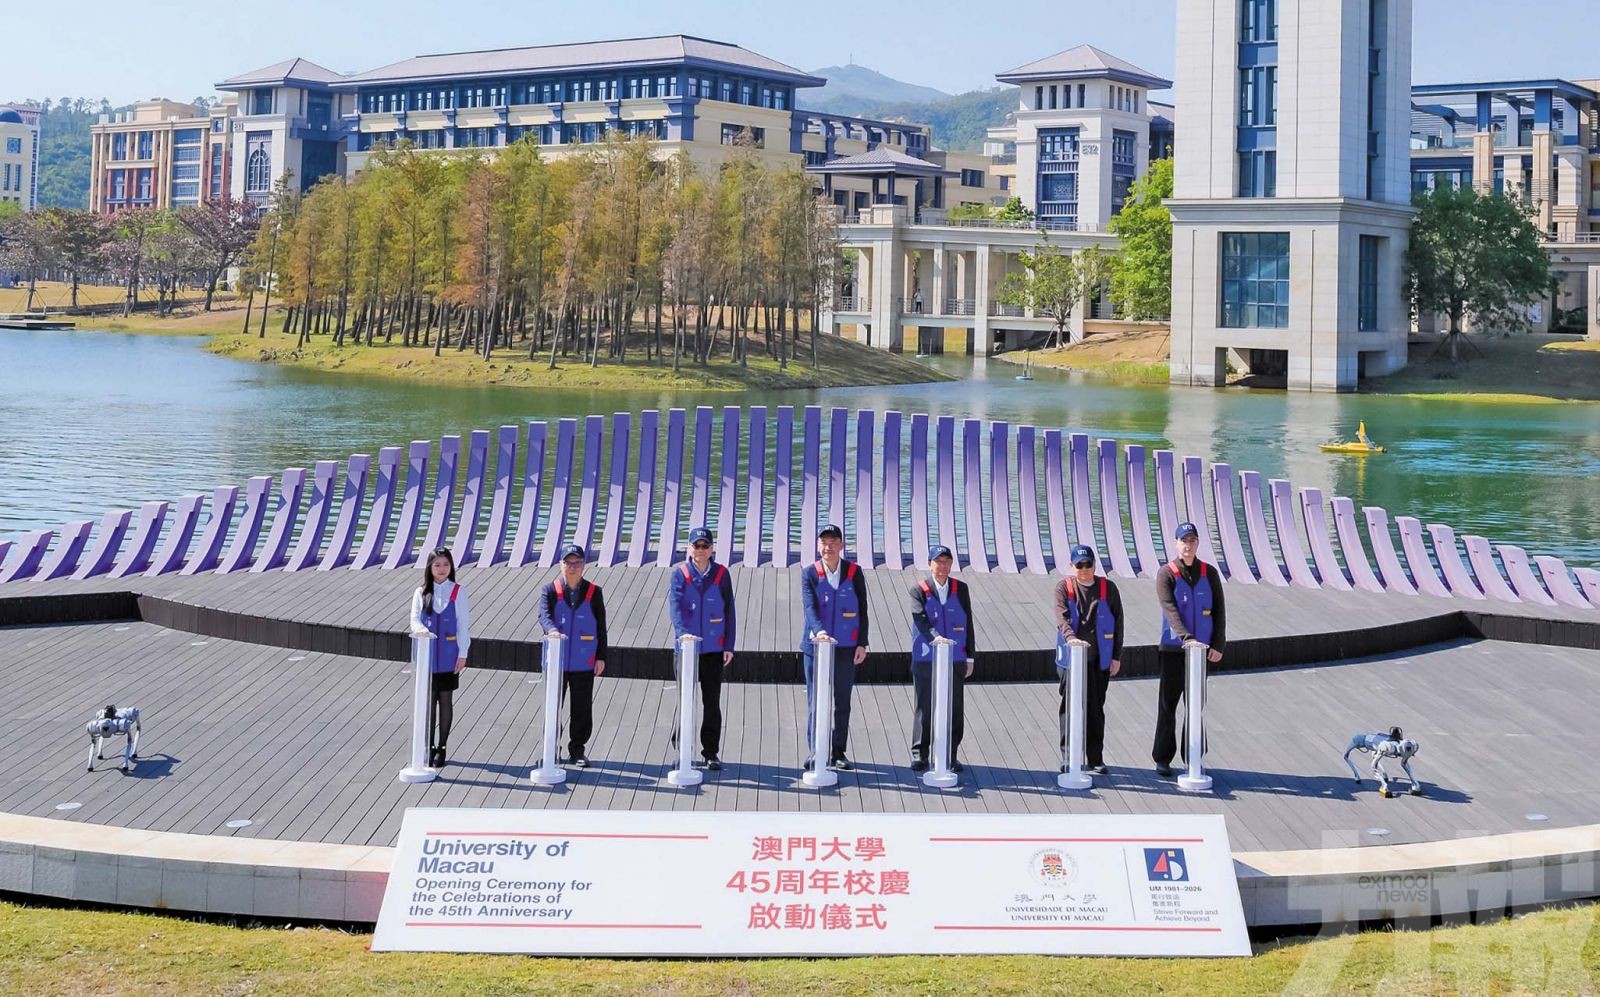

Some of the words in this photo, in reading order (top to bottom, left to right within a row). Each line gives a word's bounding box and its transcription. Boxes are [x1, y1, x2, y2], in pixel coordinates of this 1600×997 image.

[1082, 144, 1099, 155] E32
[421, 838, 537, 859] University
[546, 840, 570, 857] of
[752, 835, 886, 862] 澳門大學
[417, 857, 494, 874] Macau
[415, 878, 481, 893] Opening
[486, 878, 566, 894] Ceremony
[570, 879, 593, 891] for
[726, 869, 910, 896] 45周年校慶
[412, 891, 437, 903] the
[441, 891, 541, 904] Celebrations
[545, 891, 563, 904] of
[409, 904, 434, 917] the
[438, 905, 473, 917] 45th
[477, 905, 573, 920] Anniversary
